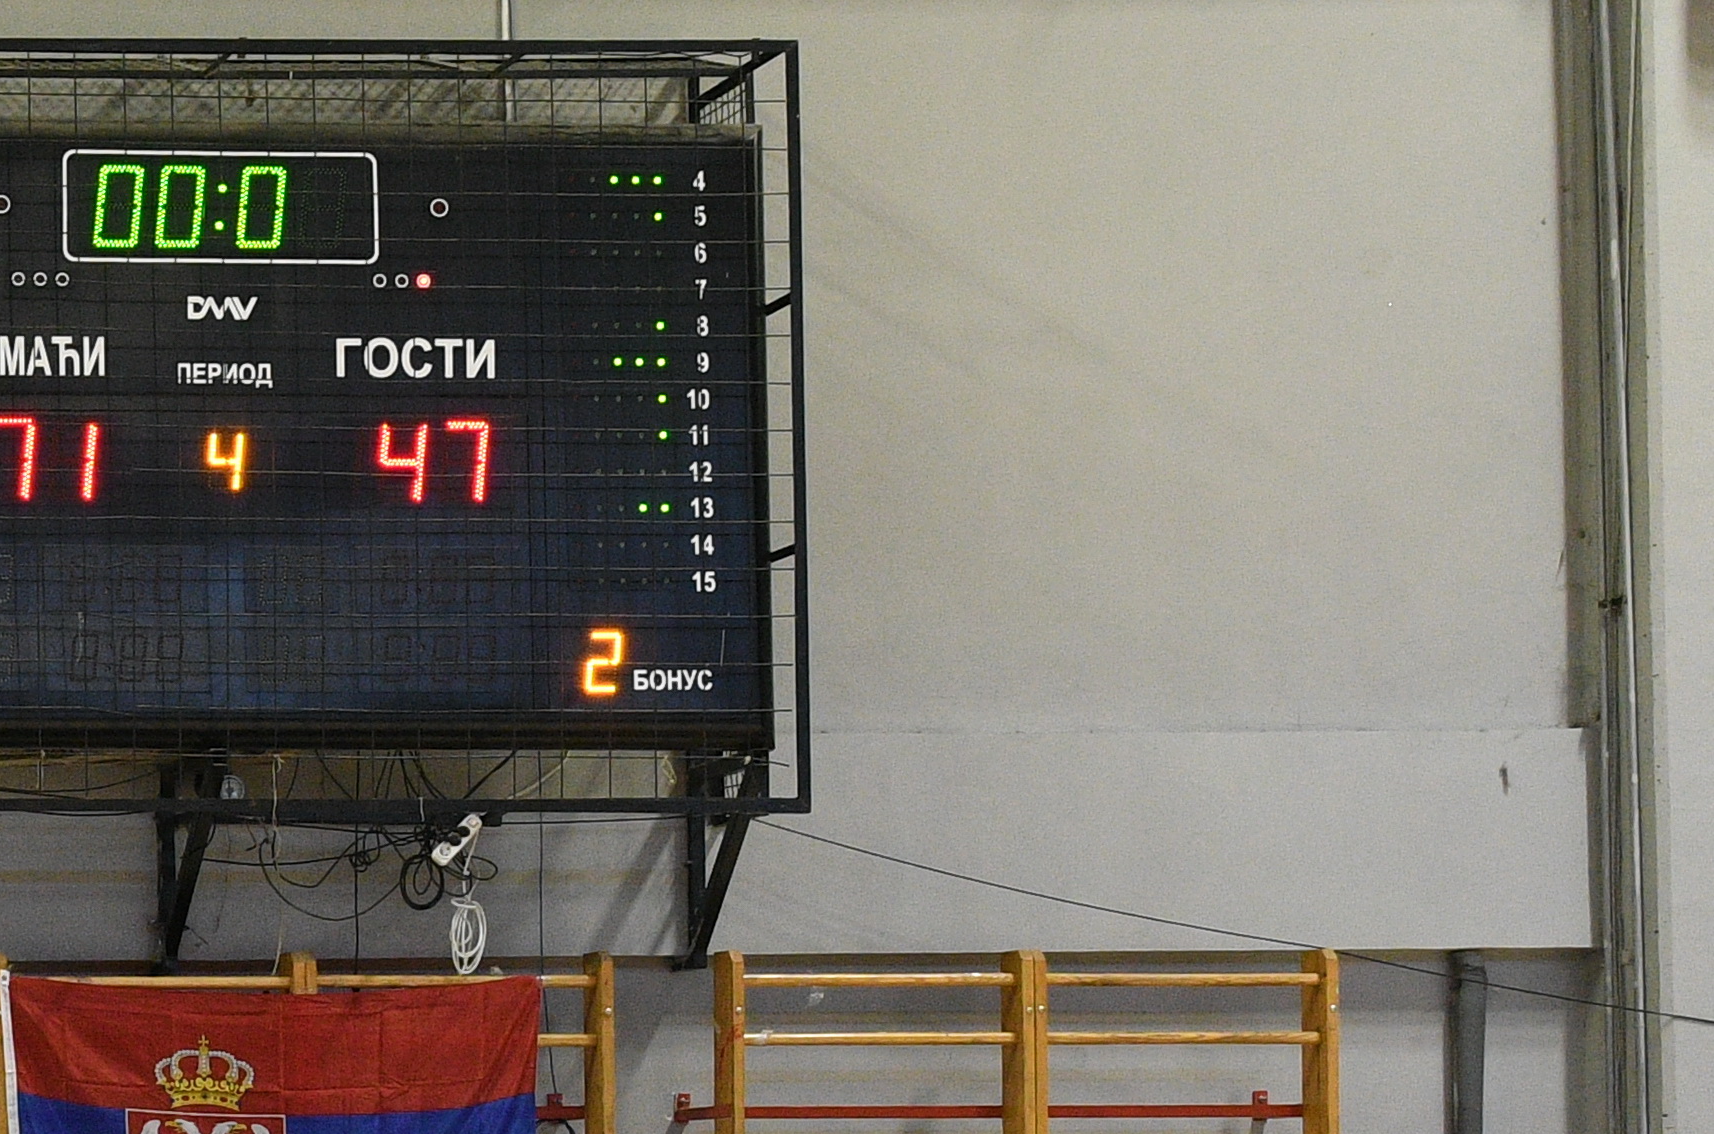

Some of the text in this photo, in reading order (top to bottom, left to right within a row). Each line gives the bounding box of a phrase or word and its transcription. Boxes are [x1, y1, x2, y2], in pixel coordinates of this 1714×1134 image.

[693, 170, 706, 191] 4
[92, 164, 287, 249] 00:0
[694, 205, 707, 226] 5
[694, 242, 707, 263] 6
[695, 279, 707, 300] 7
[696, 315, 709, 337] 8
[335, 337, 496, 379] ГОСТИ
[697, 352, 709, 373] 9
[177, 363, 273, 388] ПЕРИОД
[687, 388, 710, 410] 10
[689, 425, 709, 446] 11
[206, 432, 247, 491] 4
[378, 420, 489, 502] 47
[689, 461, 713, 482] 12
[691, 497, 714, 518] 13
[691, 534, 714, 555] 14
[692, 571, 716, 592] 15
[584, 629, 713, 695] 2 БОНУС
